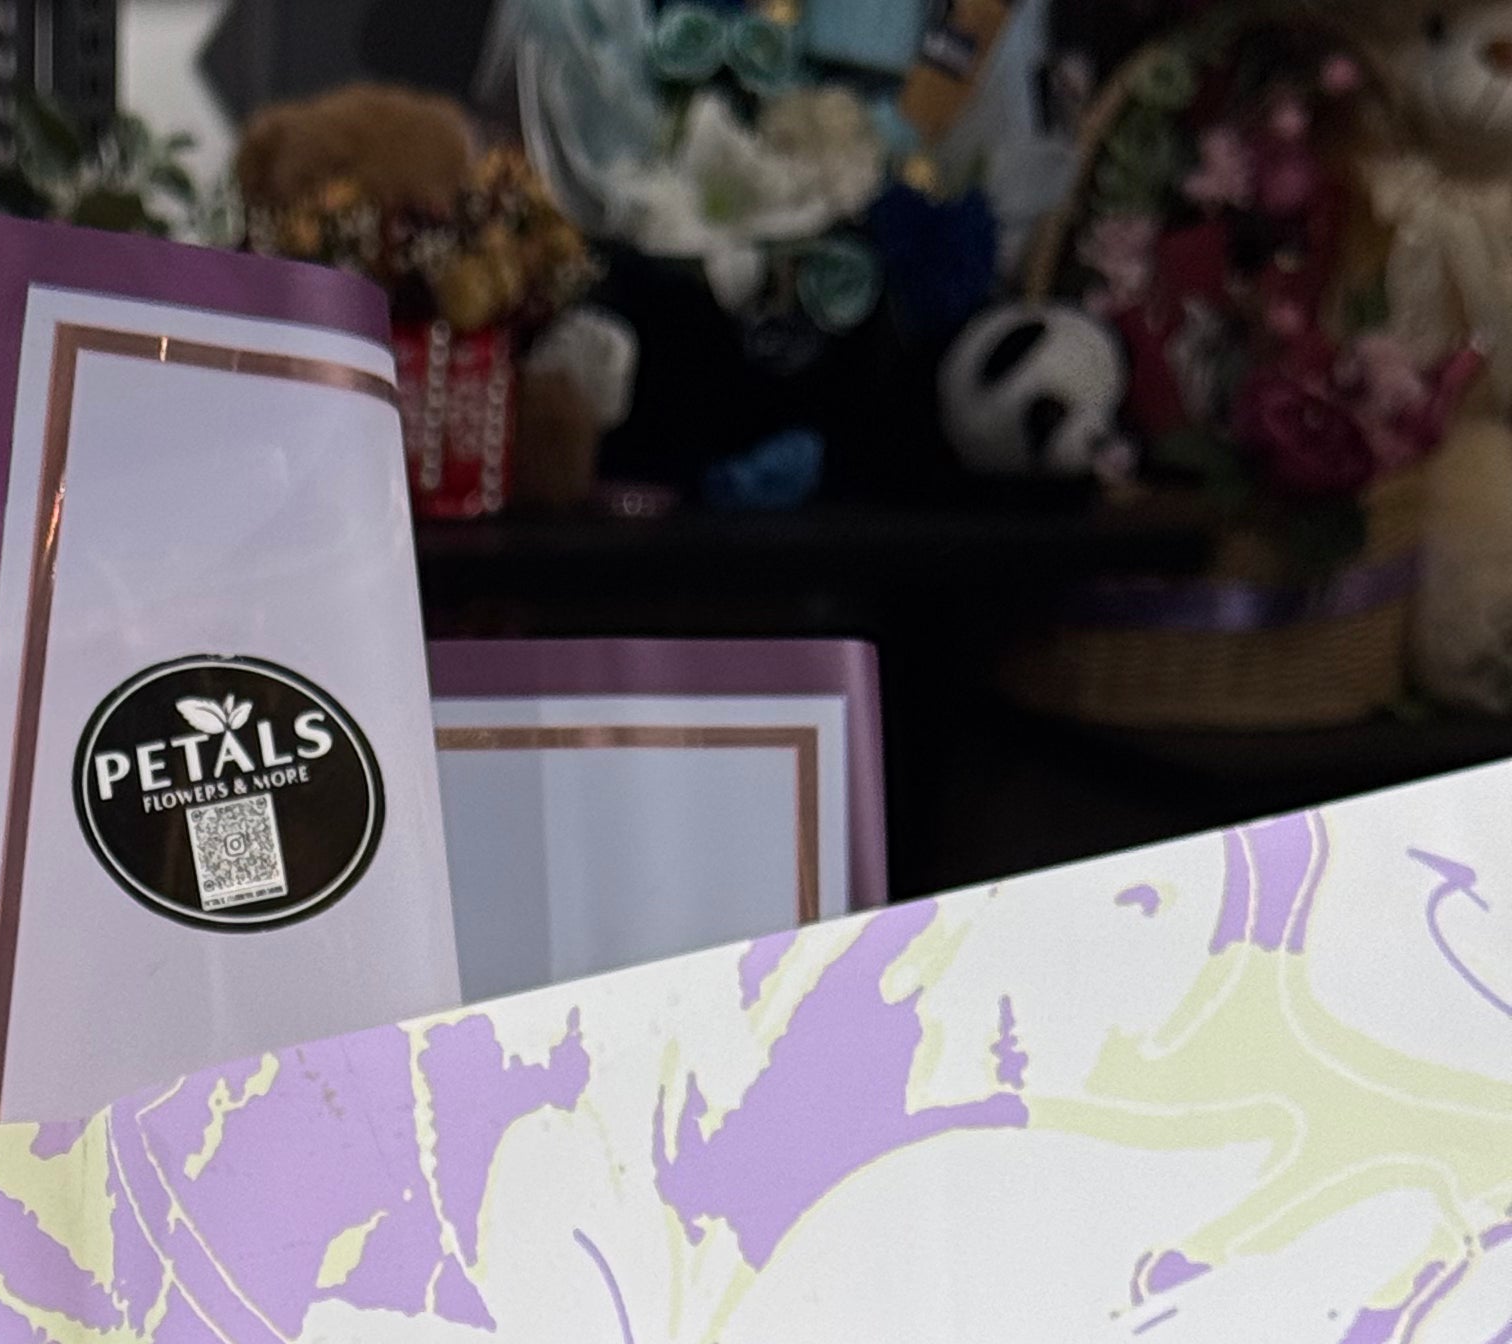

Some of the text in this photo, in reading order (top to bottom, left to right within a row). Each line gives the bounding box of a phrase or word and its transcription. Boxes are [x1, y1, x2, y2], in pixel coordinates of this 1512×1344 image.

[94, 709, 333, 801] PETALS
[143, 765, 310, 814] FLOWERS & MORE
